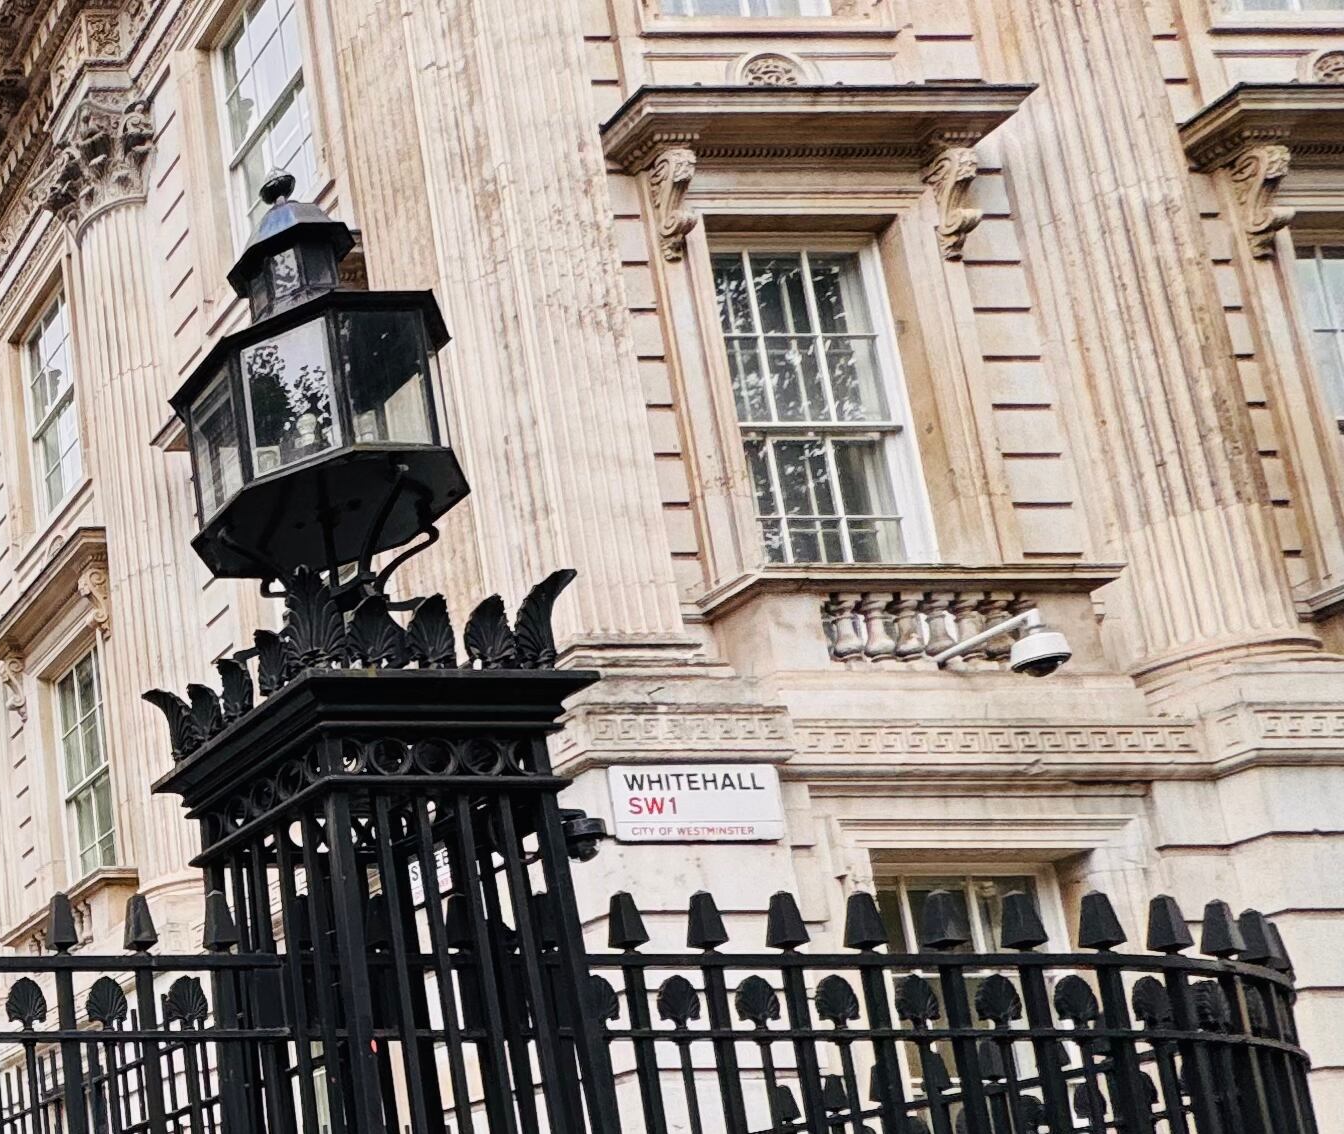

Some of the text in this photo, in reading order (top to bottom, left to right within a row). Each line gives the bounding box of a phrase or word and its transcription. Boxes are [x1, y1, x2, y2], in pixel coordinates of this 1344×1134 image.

[623, 773, 765, 791] WHITEHALL
[628, 797, 678, 815] SW1
[631, 825, 755, 836] CITY OF WESTMINSTER
